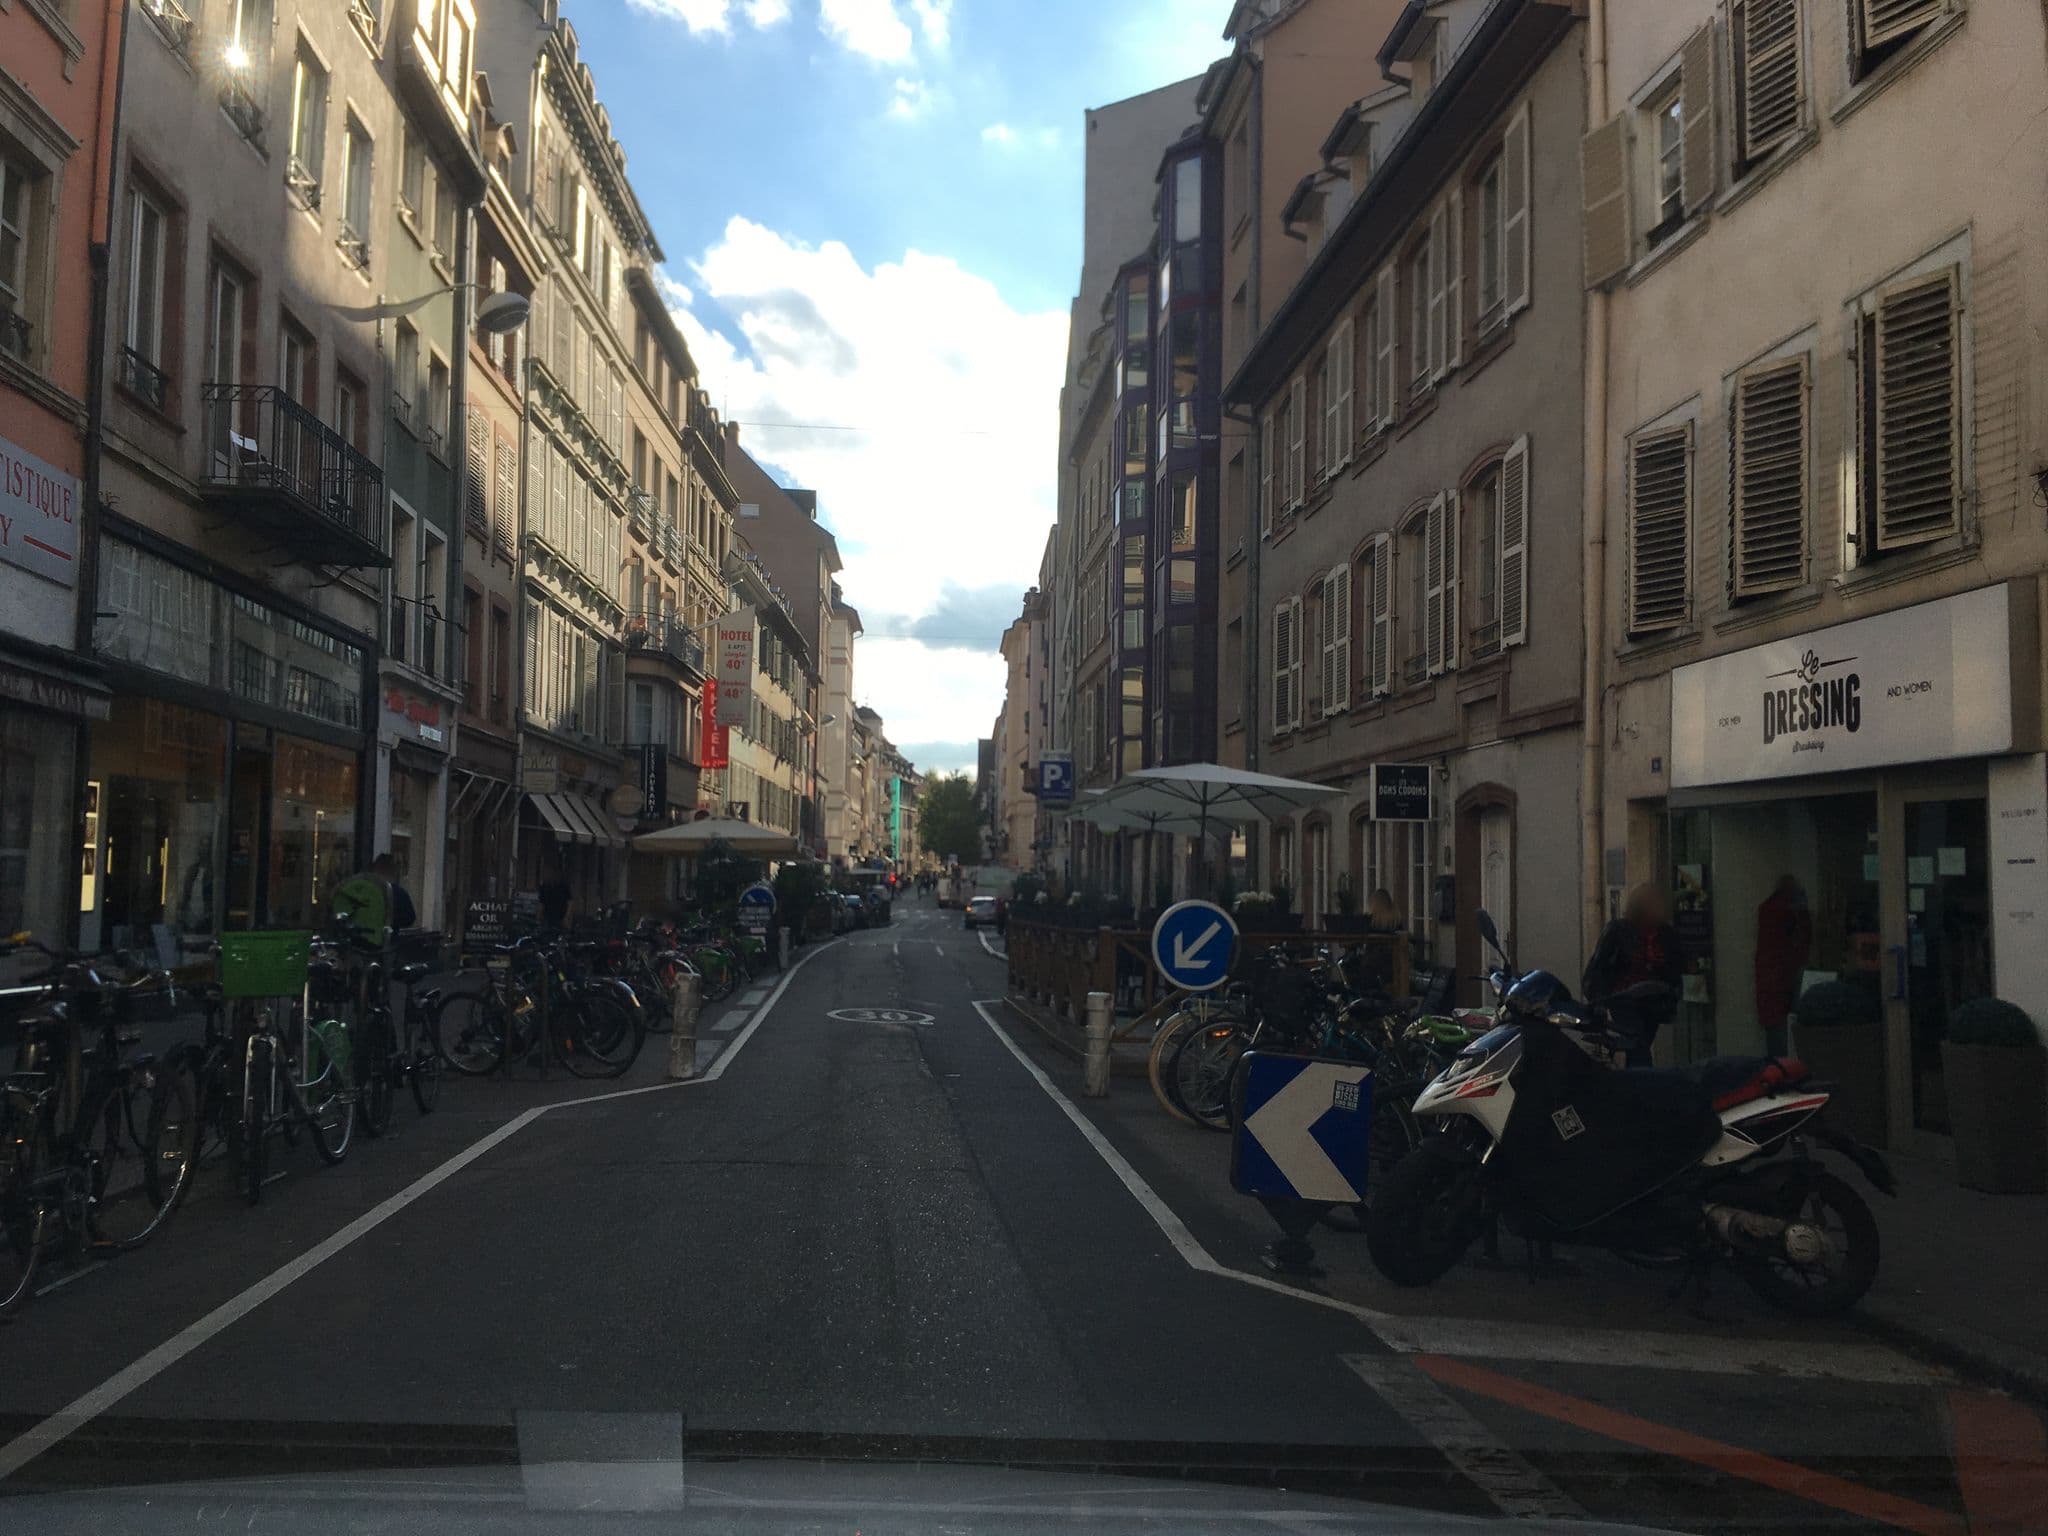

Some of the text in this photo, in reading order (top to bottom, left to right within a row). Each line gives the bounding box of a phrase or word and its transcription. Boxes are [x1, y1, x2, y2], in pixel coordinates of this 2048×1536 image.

[0, 452, 73, 523] ISTIQUE
[720, 629, 752, 641] HOTEL
[1796, 649, 1820, 683] Le
[1903, 680, 1934, 695] WOMEN
[1763, 673, 1861, 745] DRESSING
[1730, 716, 1741, 725] MEN
[1043, 763, 1063, 789] P
[469, 901, 508, 912] ACHAT
[479, 913, 498, 922] OR
[857, 1011, 909, 1021] 30
